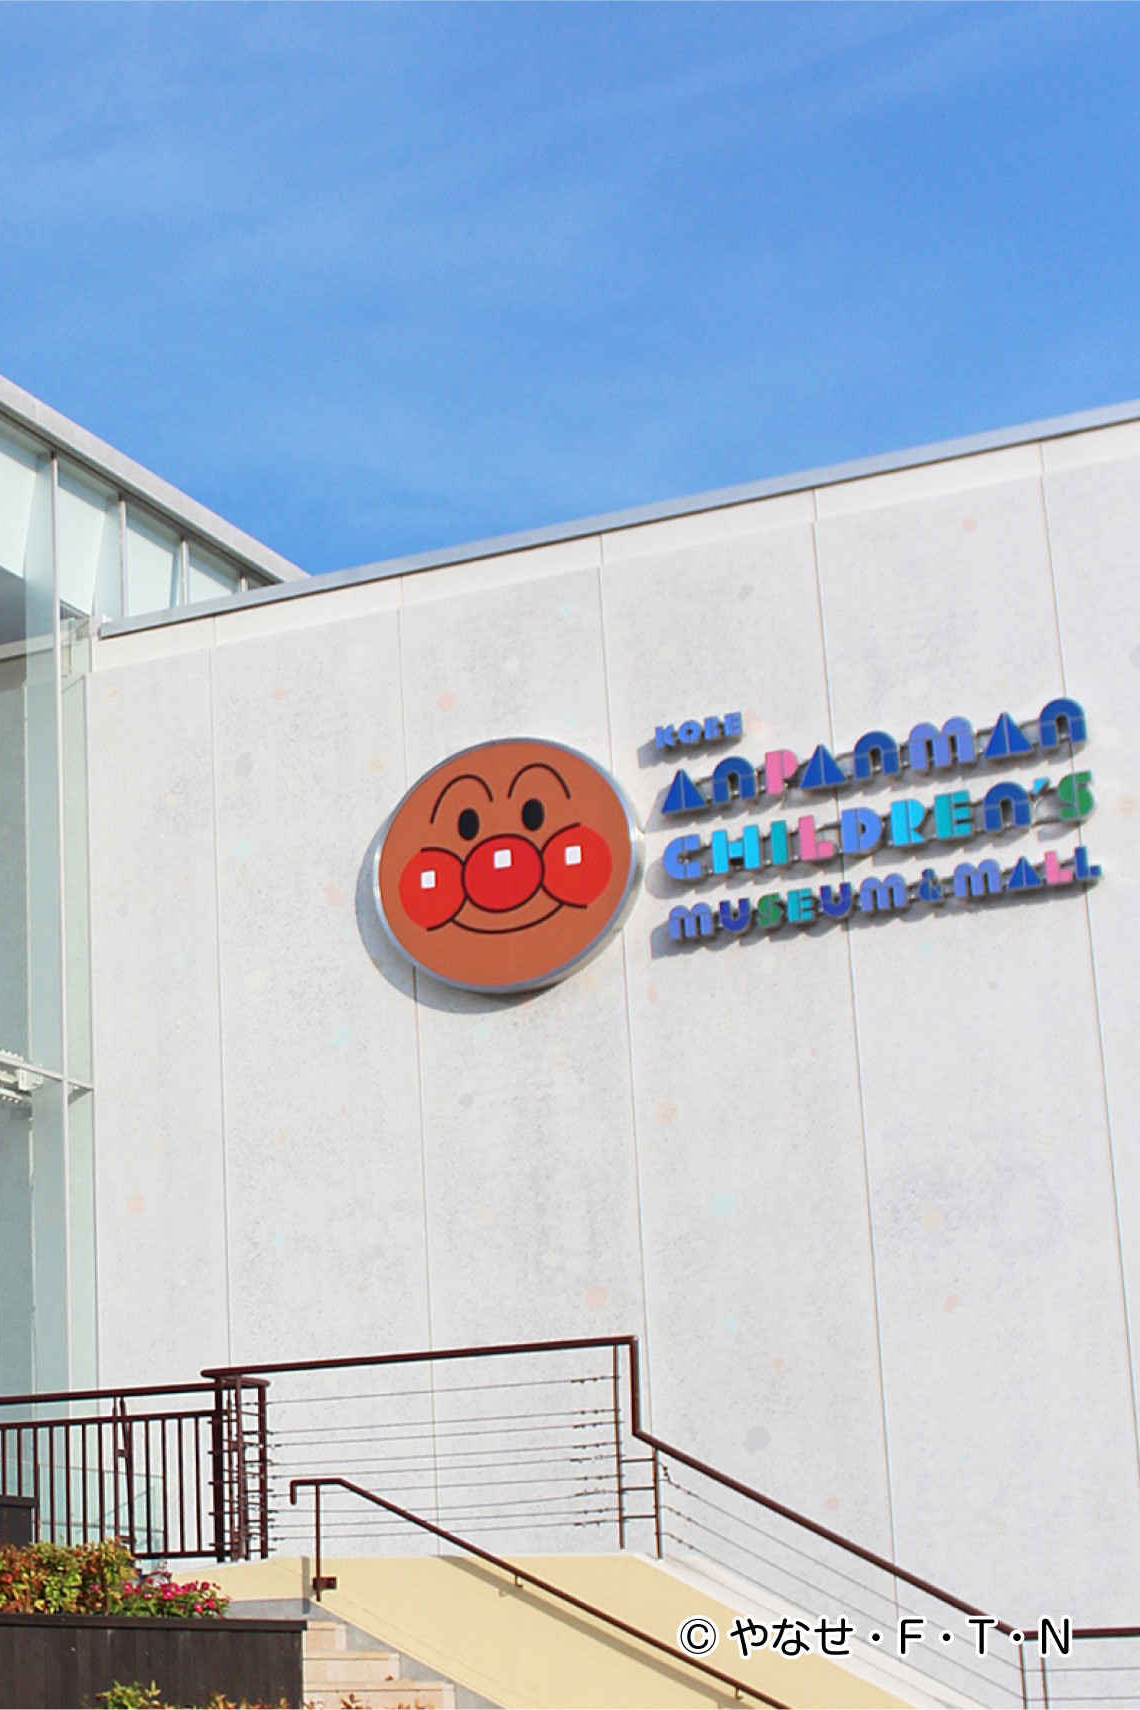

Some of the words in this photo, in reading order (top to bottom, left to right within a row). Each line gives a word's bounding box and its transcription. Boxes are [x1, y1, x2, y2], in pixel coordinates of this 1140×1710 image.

[654, 711, 743, 749] KOBE
[660, 697, 1088, 814] ANPANMAN
[663, 770, 1095, 880] CHILDREN'S
[668, 872, 907, 941] MUSEUM
[918, 868, 945, 902] &
[954, 846, 1102, 898] MALL
